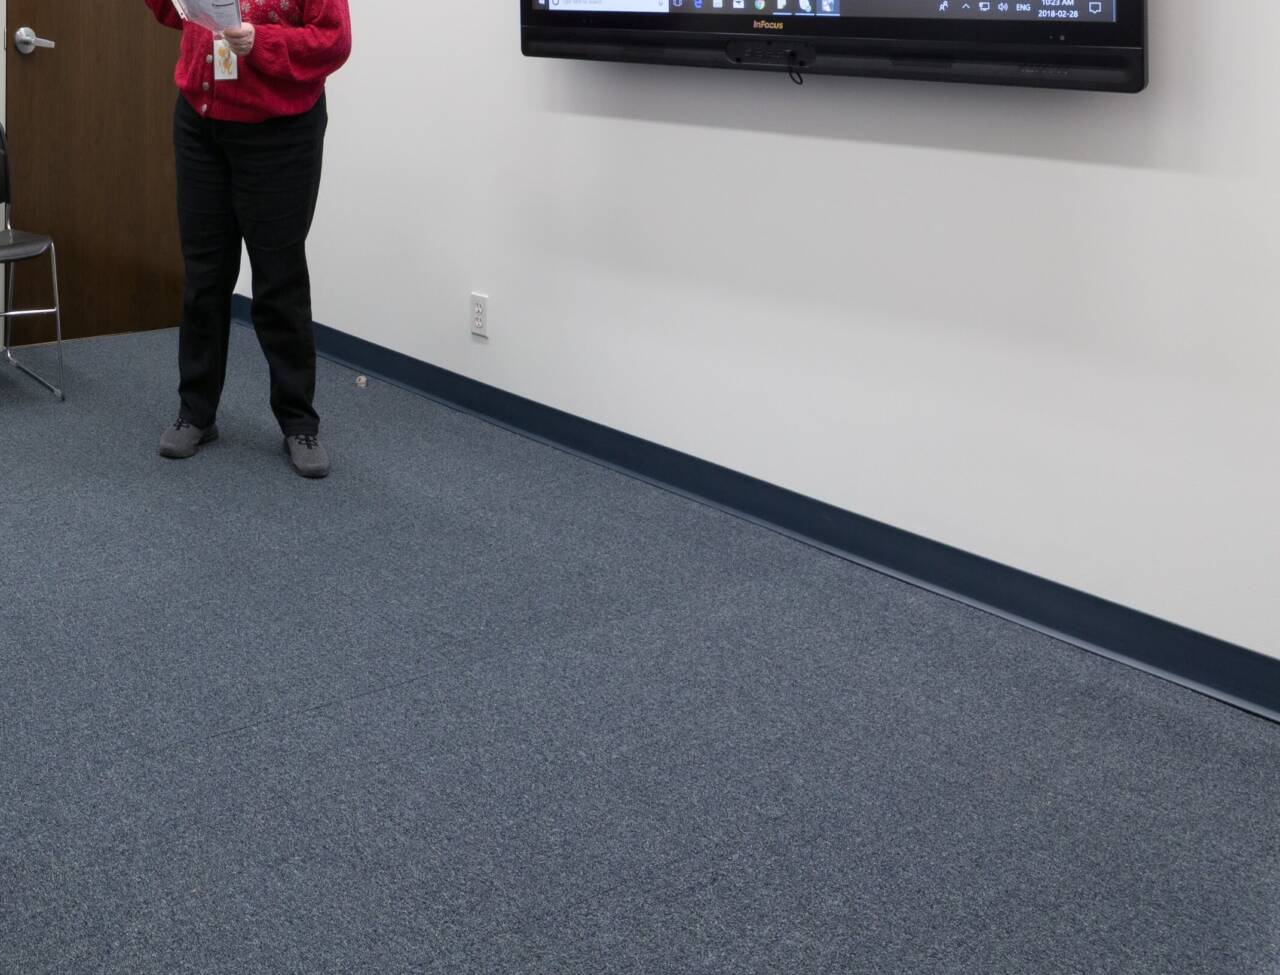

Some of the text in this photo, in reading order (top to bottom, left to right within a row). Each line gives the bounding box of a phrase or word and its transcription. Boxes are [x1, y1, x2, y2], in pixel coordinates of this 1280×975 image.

[1016, 3, 1031, 12] ENG
[1037, 9, 1079, 19] 2018-02-28
[753, 19, 784, 31] InFocus
